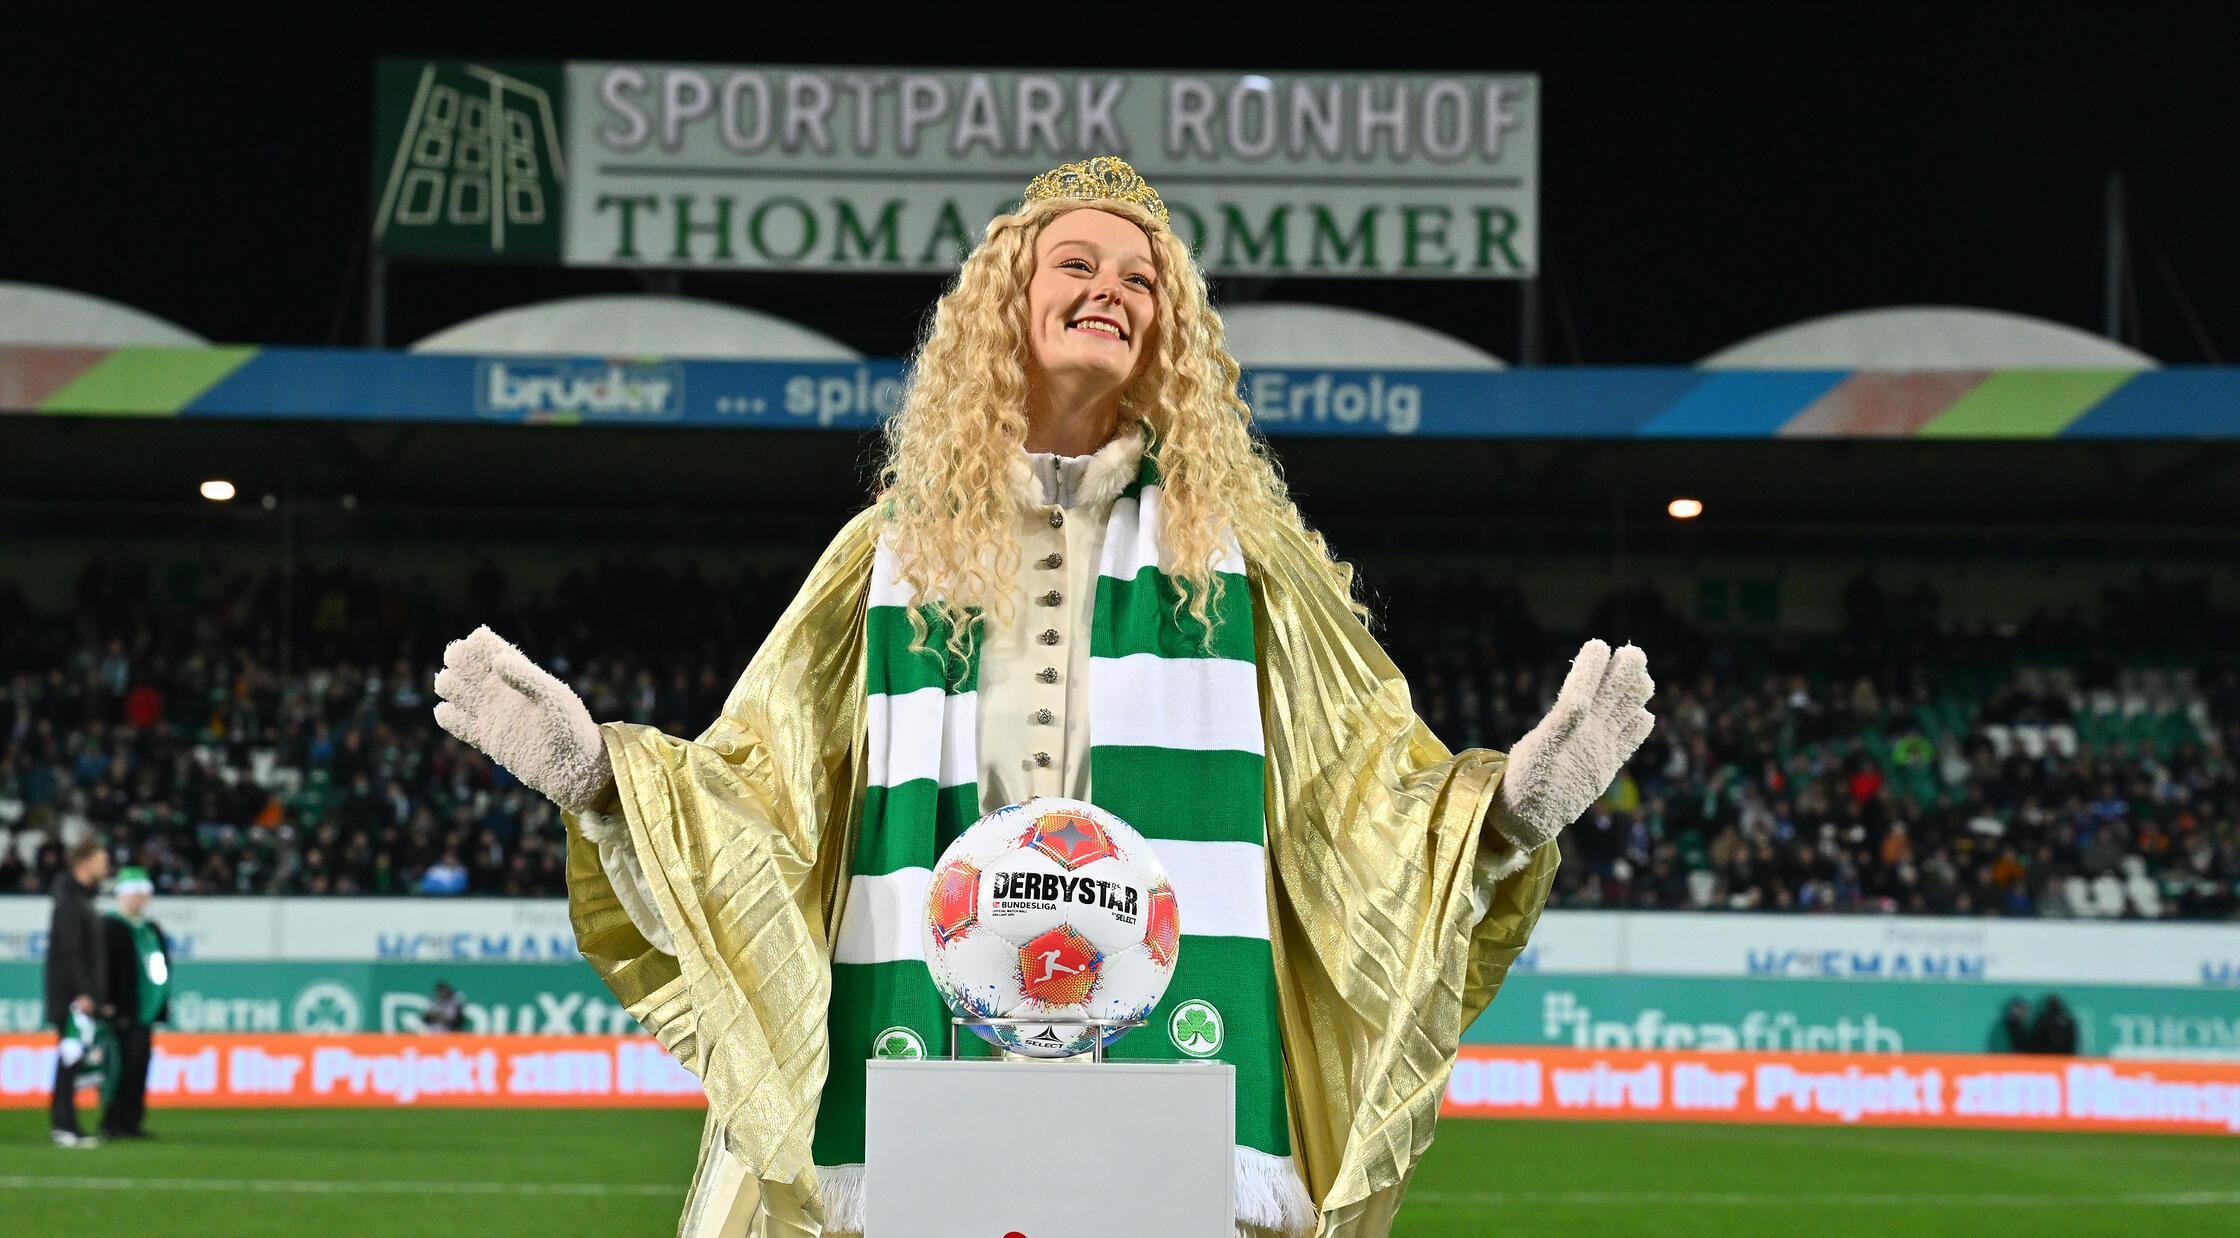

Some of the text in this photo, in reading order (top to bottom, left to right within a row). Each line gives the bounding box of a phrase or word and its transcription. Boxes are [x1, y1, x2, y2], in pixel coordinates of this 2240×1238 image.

[600, 66, 1526, 163] SPORTPARK RONHOF
[597, 195, 1524, 276] THOMA MMER
[784, 366, 904, 425] spie
[1252, 373, 1421, 435] Erfolg
[993, 872, 1138, 916] DERBYSTAR
[1001, 901, 1057, 911] BUNDESLIGA
[1115, 913, 1136, 925] SELECT
[172, 992, 279, 1031] ÜRTH
[1025, 1039, 1064, 1049] SELECT
[149, 1046, 217, 1094] ird
[229, 1047, 303, 1094] Ihr
[312, 1048, 497, 1105] Projekt
[508, 1051, 612, 1094] zum
[1447, 1058, 1541, 1106] OBI
[1551, 1061, 1661, 1109] wird
[1672, 1062, 1747, 1110] Ihr
[1754, 1064, 1943, 1122] Projekt
[1954, 1072, 2060, 1117] zum
